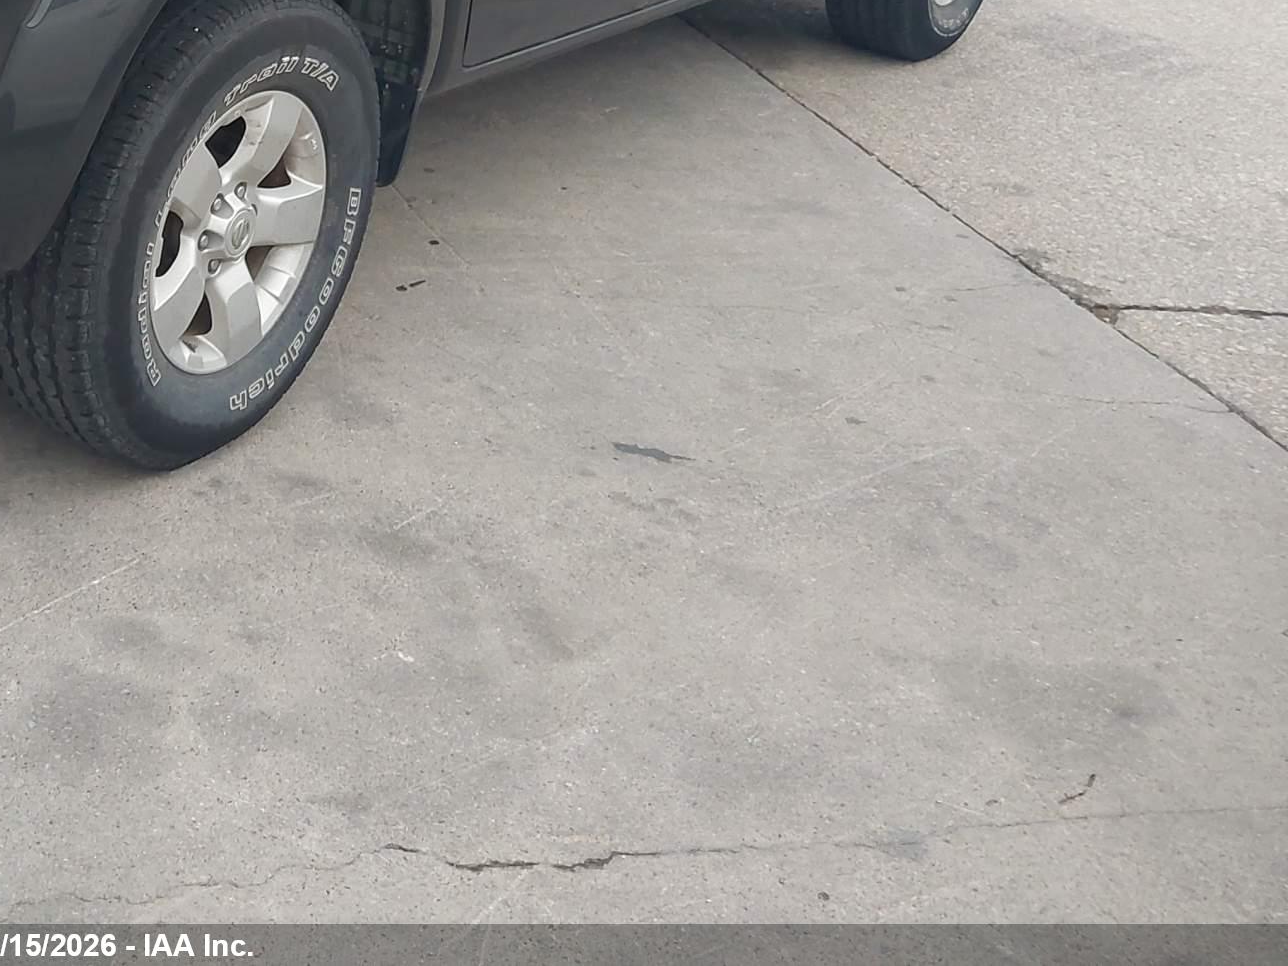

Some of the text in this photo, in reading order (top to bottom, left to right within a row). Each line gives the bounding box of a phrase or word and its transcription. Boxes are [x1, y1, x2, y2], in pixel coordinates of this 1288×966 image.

[137, 242, 162, 387] Radial
[224, 56, 300, 107] Trail
[301, 57, 340, 92] T/A
[230, 187, 362, 411] BFGoodrich
